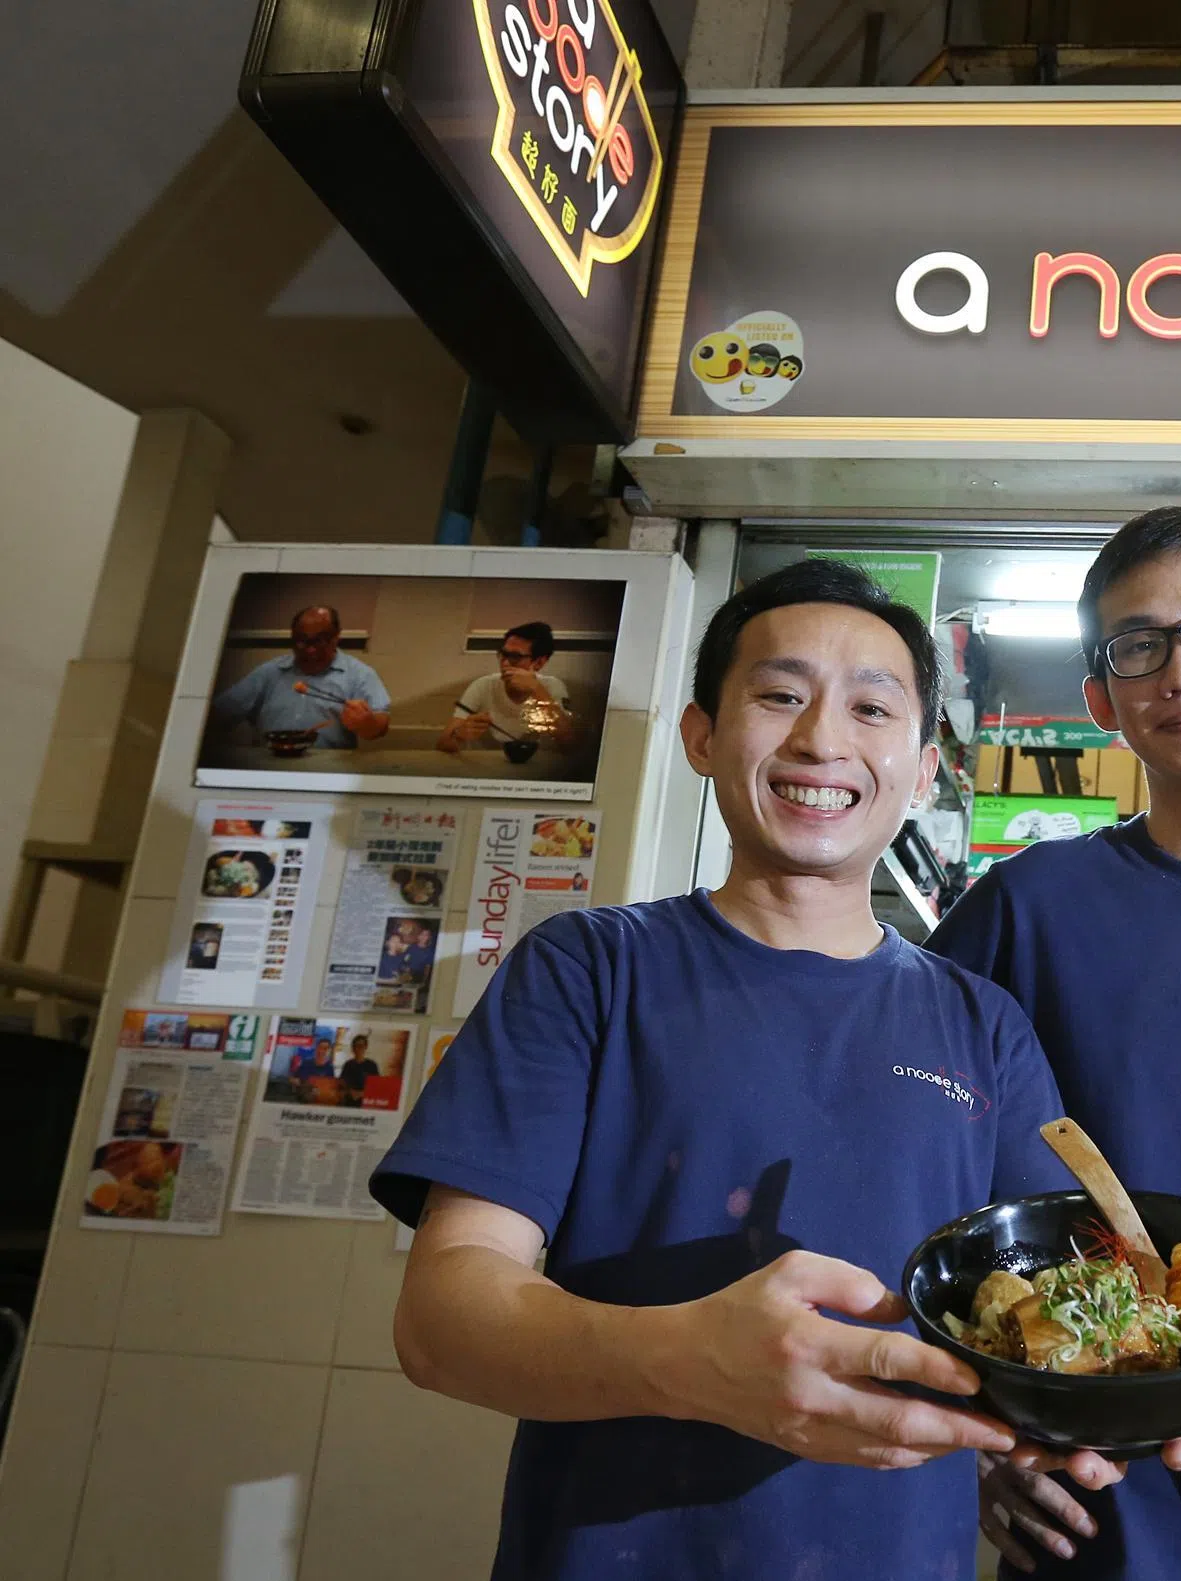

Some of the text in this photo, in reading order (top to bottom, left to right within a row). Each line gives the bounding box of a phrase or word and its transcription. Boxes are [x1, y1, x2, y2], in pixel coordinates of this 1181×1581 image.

[501, 4, 618, 232] story
[896, 252, 989, 334] a
[281, 1109, 376, 1126] Hawker gourmet
[893, 1065, 904, 1076] a
[953, 1081, 975, 1111] story
